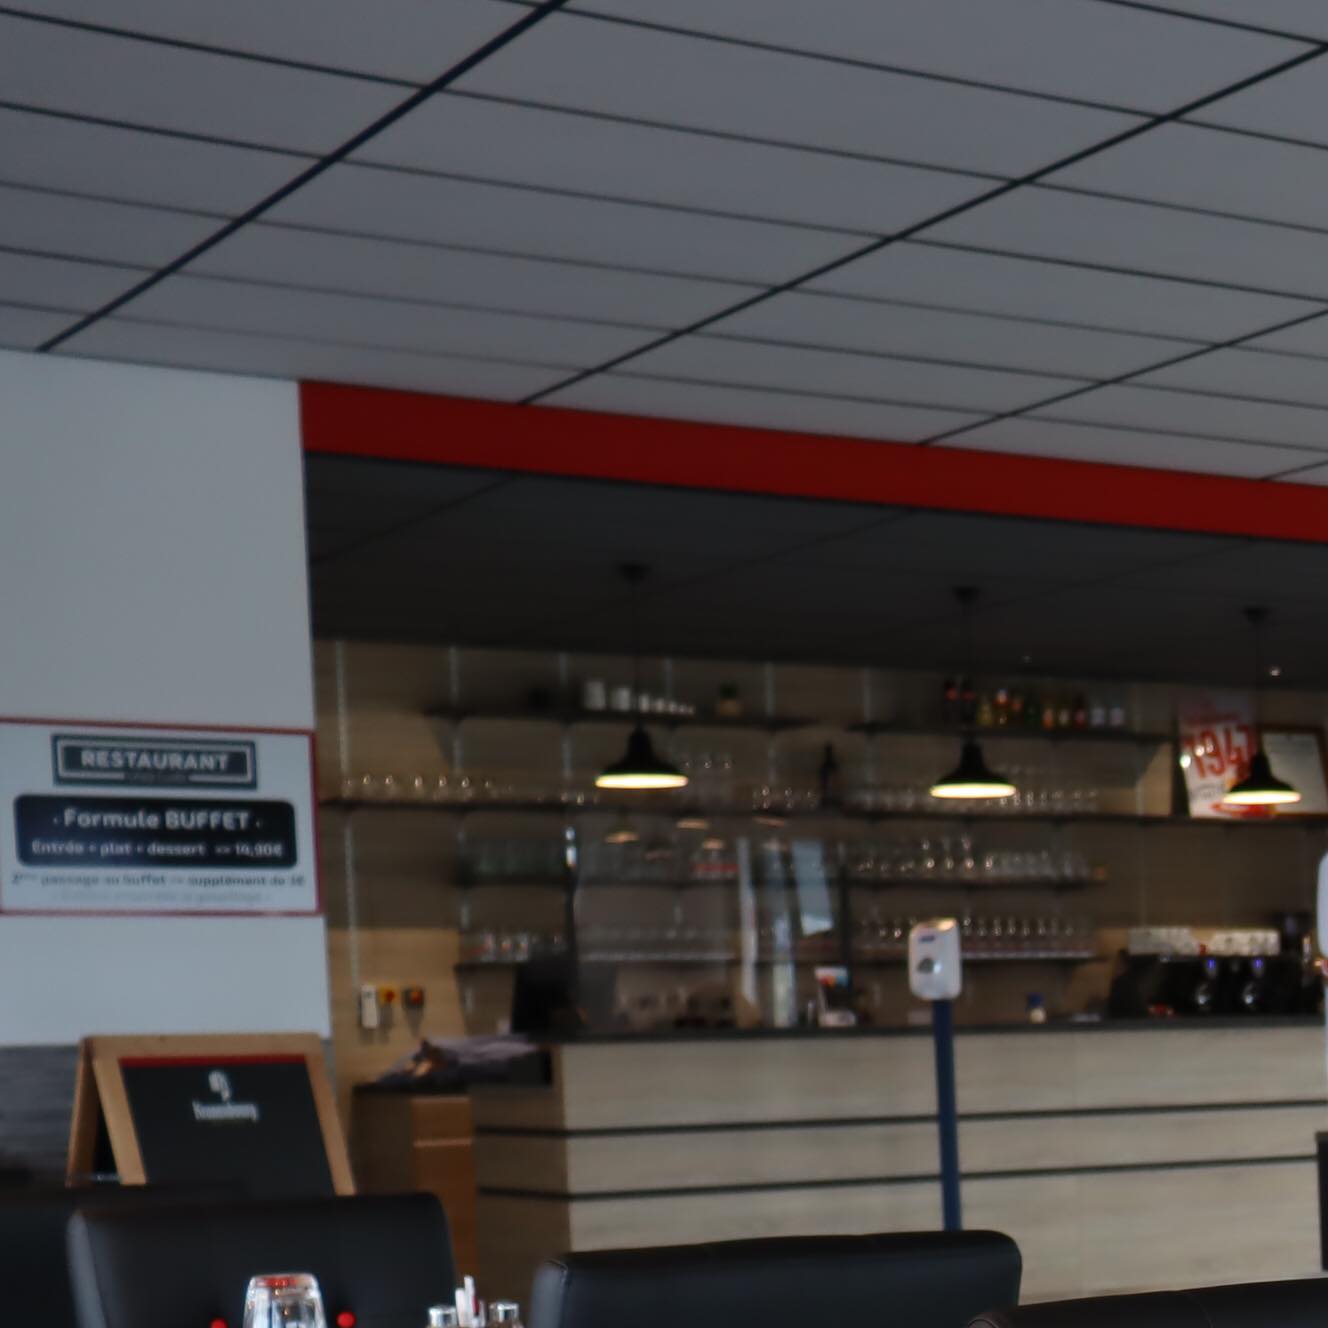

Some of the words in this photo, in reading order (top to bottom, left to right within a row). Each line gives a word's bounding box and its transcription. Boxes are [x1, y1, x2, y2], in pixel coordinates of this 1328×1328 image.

[81, 750, 229, 770] RESTAURANT
[63, 808, 161, 829] Formule
[164, 810, 250, 831] BUFFET
[100, 841, 131, 857] plat
[146, 842, 206, 856] dessert
